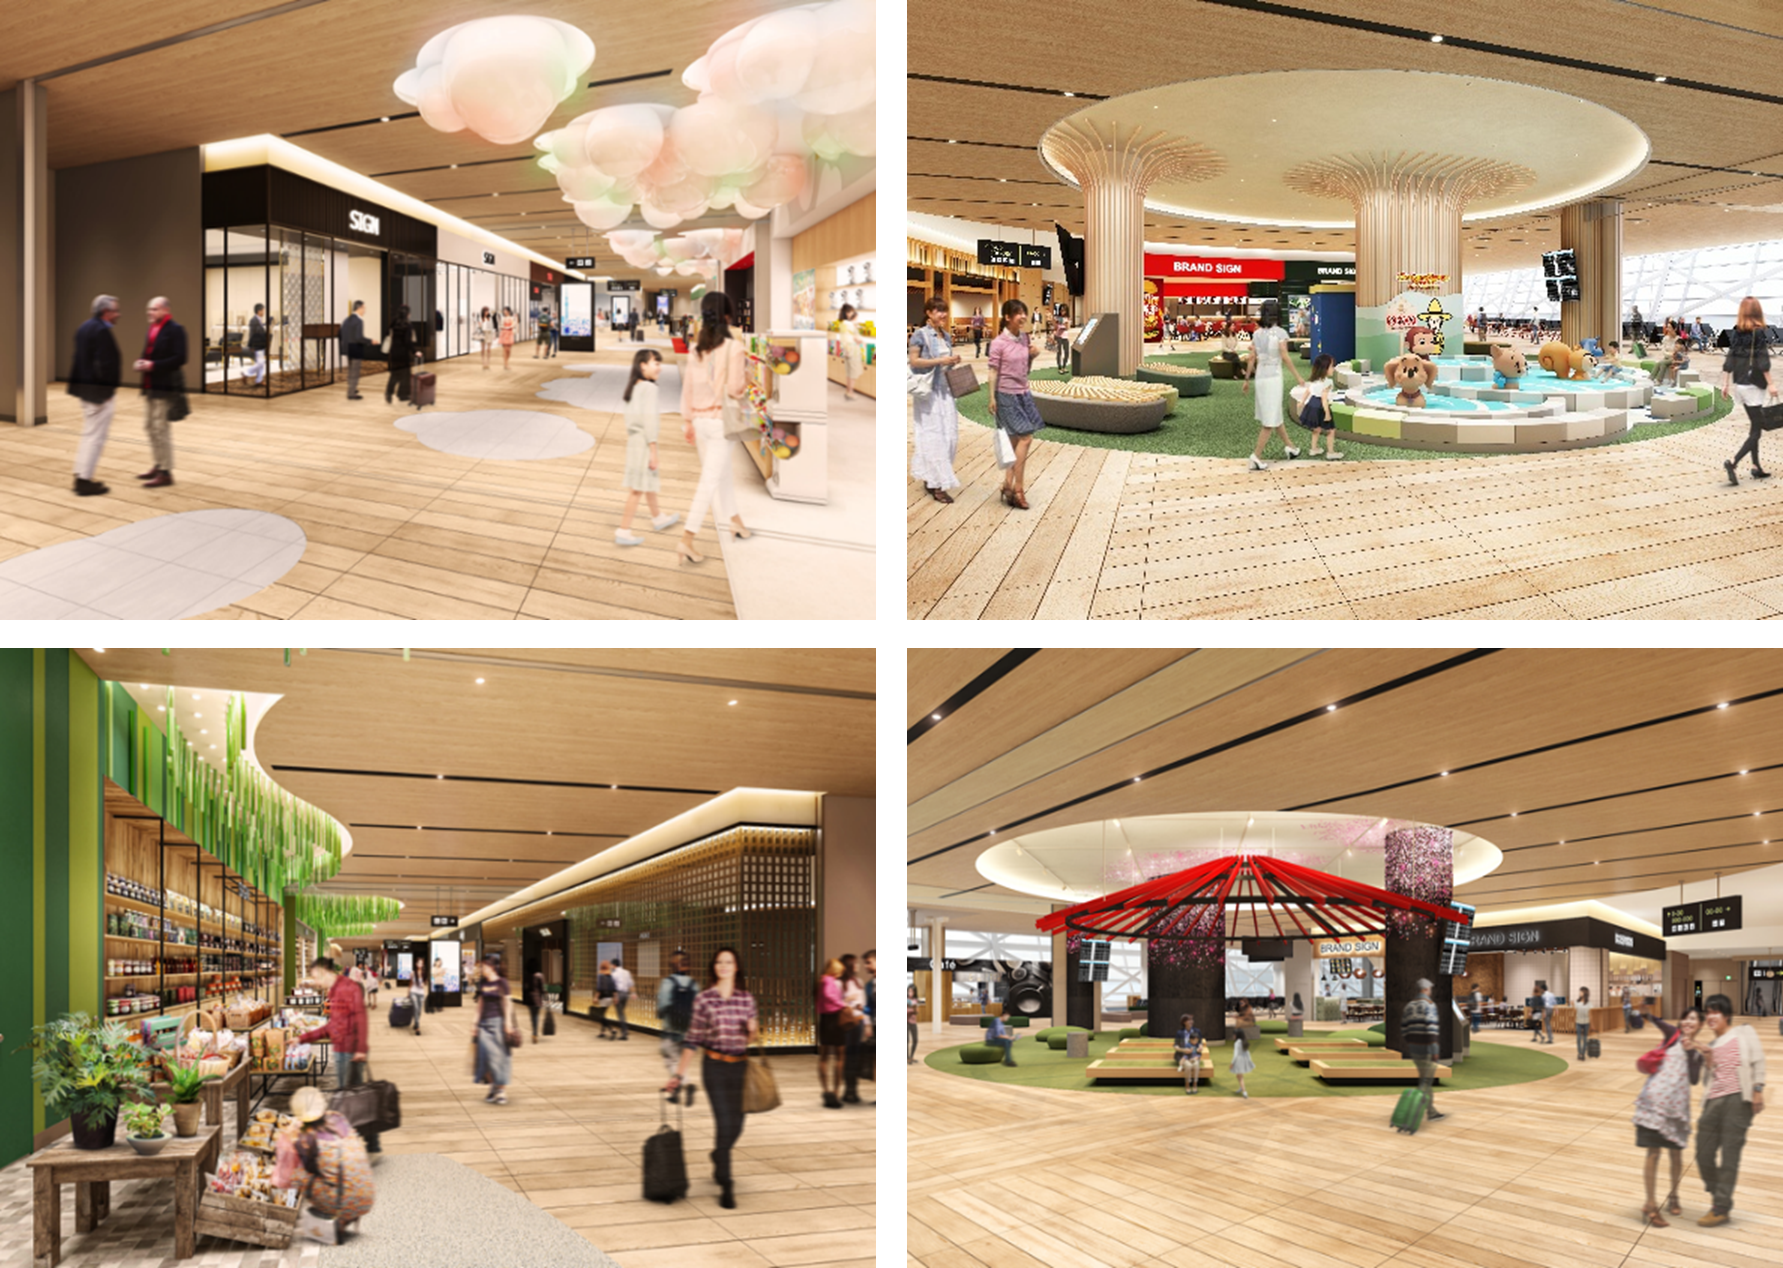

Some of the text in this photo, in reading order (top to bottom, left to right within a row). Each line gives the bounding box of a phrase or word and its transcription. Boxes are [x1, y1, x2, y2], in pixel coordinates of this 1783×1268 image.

[349, 209, 380, 236] SIGN
[1173, 262, 1242, 273] BRAND SIGN
[1470, 929, 1540, 946] RAND SIGN
[1320, 941, 1379, 954] BRAND SIGN
